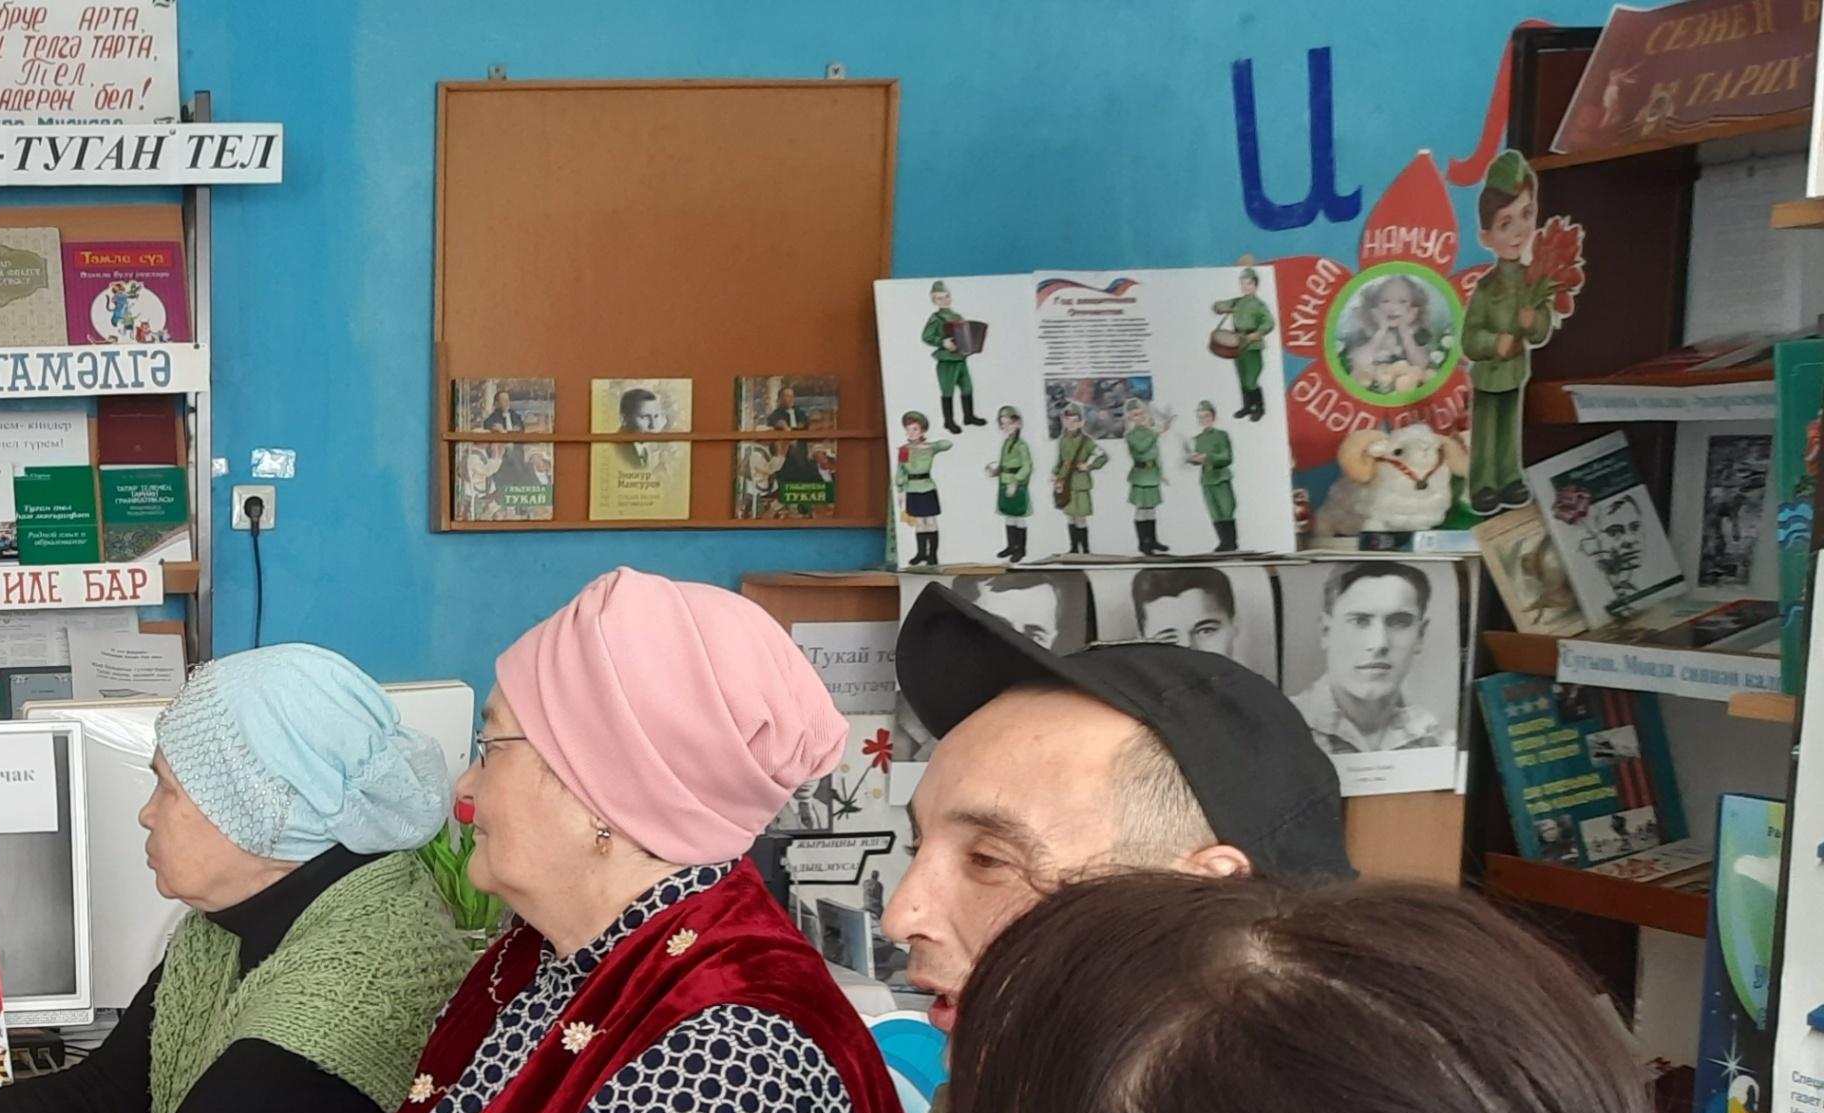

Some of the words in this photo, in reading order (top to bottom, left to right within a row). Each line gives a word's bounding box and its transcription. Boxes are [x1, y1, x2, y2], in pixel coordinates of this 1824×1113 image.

[185, 133, 278, 171] ТЕЛ
[1362, 226, 1456, 264] НАМУС
[504, 494, 546, 504] ТУКАЙ
[784, 492, 827, 502] ТУКАЙ
[3, 571, 62, 604] ИЛЕ
[83, 568, 148, 602] БАР
[808, 647, 870, 669] Тукай
